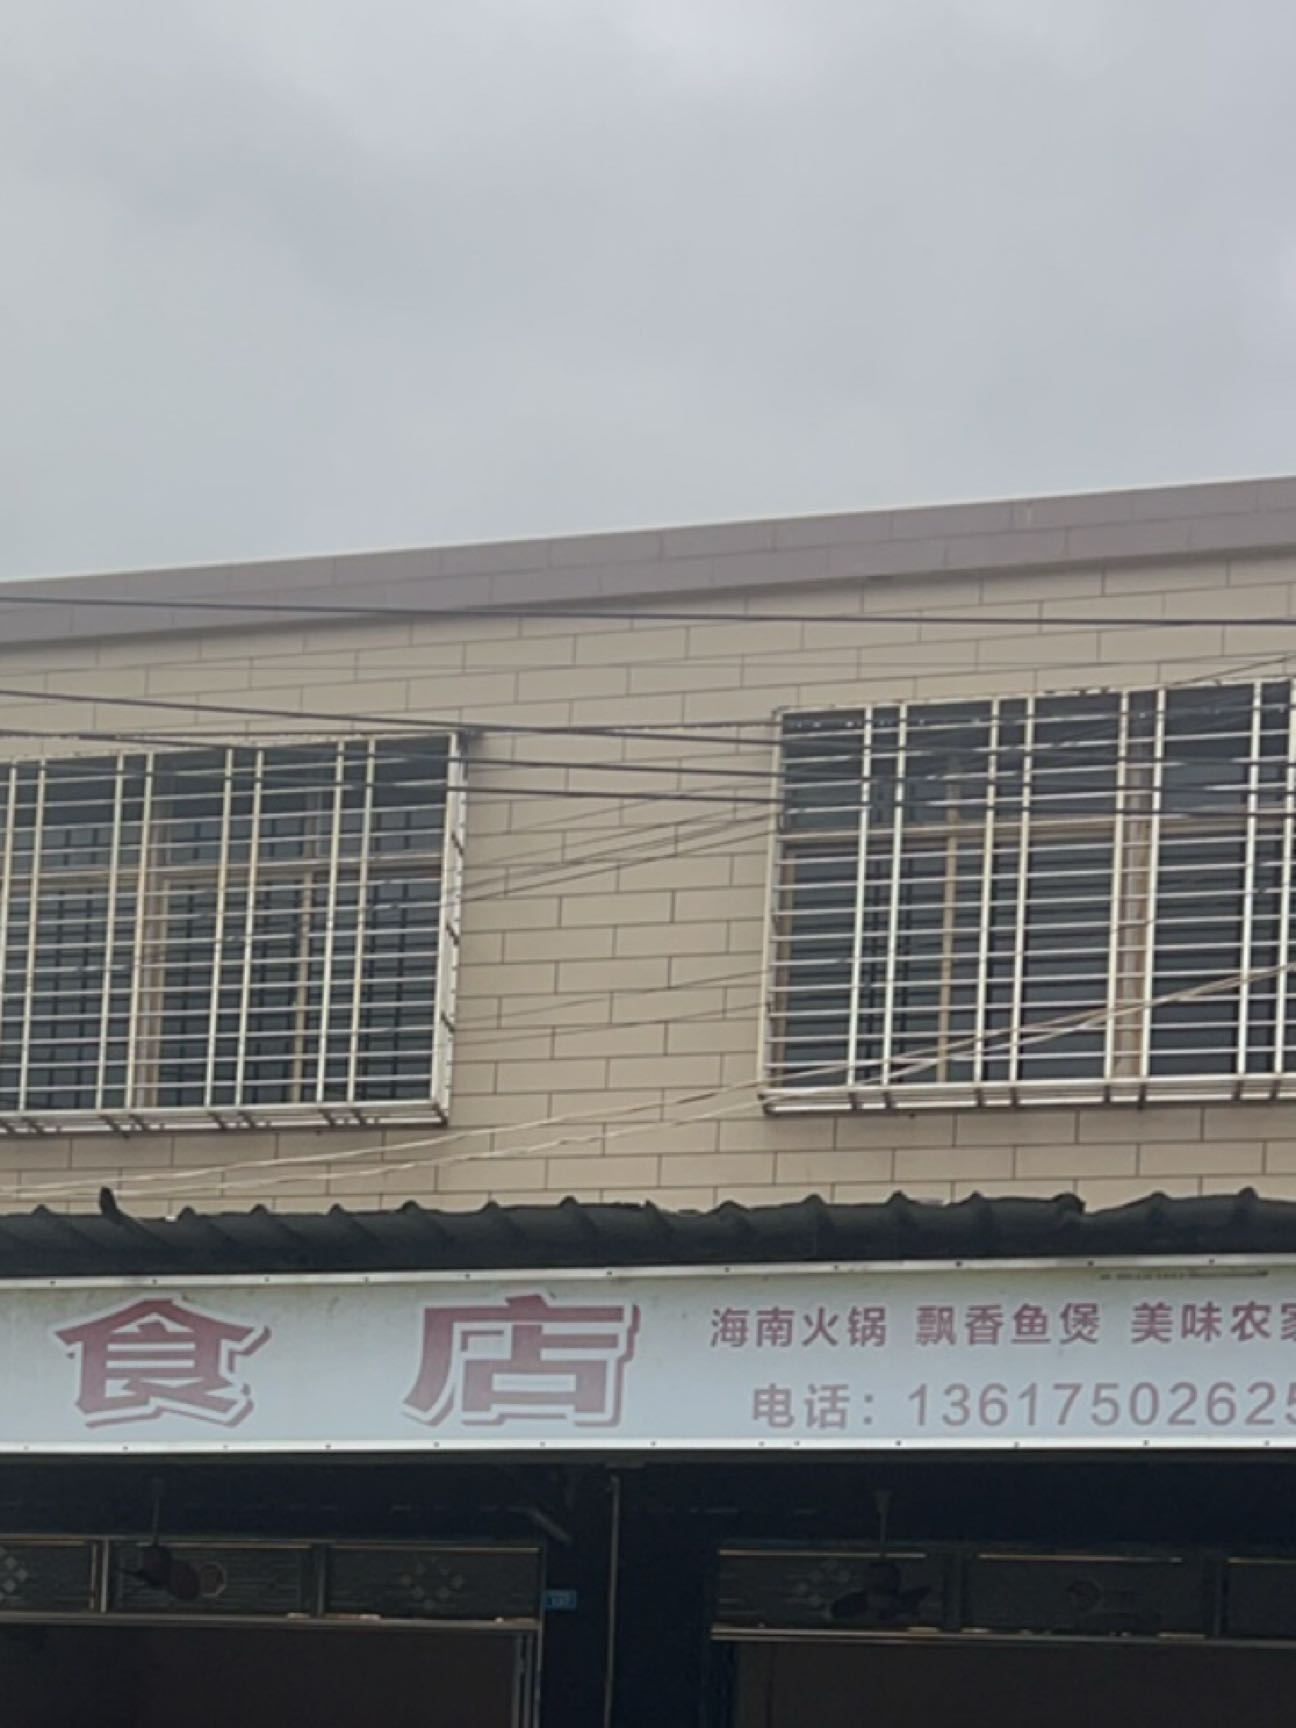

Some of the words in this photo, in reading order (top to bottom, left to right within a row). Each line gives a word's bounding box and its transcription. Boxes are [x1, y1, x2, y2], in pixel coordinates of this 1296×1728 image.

[710, 1306, 888, 1349] 海南火锅
[916, 1302, 1101, 1347] 飘香鱼煲
